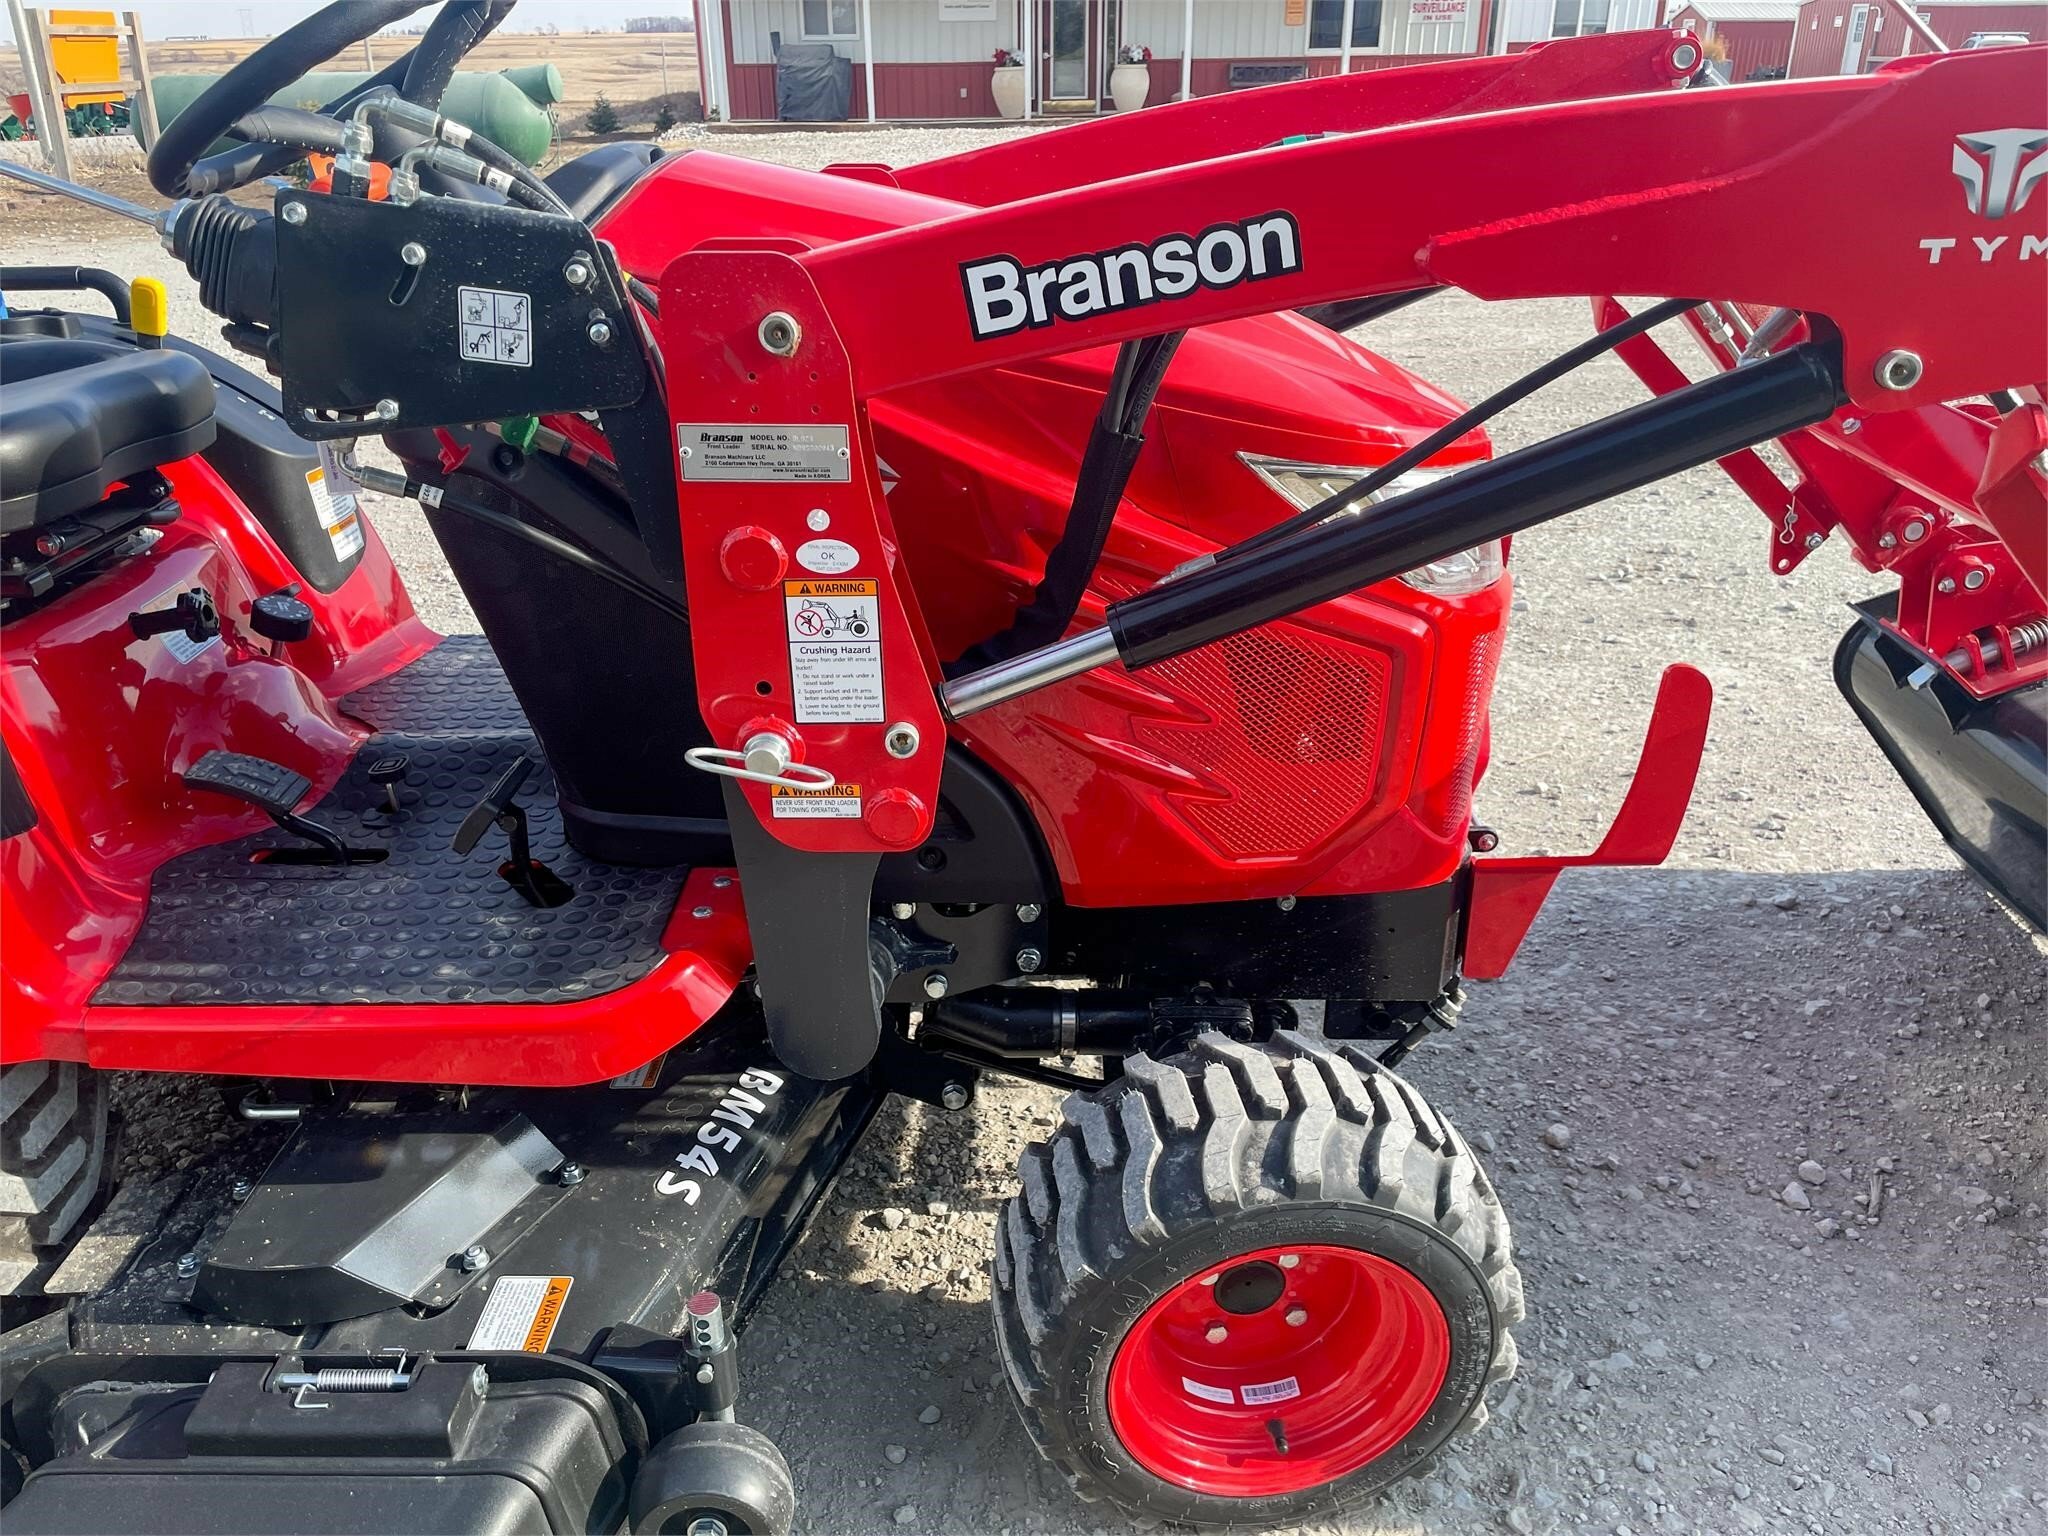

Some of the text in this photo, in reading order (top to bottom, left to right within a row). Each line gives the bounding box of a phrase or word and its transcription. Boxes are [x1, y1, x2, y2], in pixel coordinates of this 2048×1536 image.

[1412, 2, 1465, 13] SURVEILLANCE
[1919, 235, 2048, 264] TYM
[966, 217, 1296, 334] Branson
[700, 433, 743, 442] Branson
[821, 552, 835, 560] OK
[814, 583, 866, 593] WARNING
[800, 646, 837, 655] Crushing
[656, 1066, 785, 1206] BM54S
